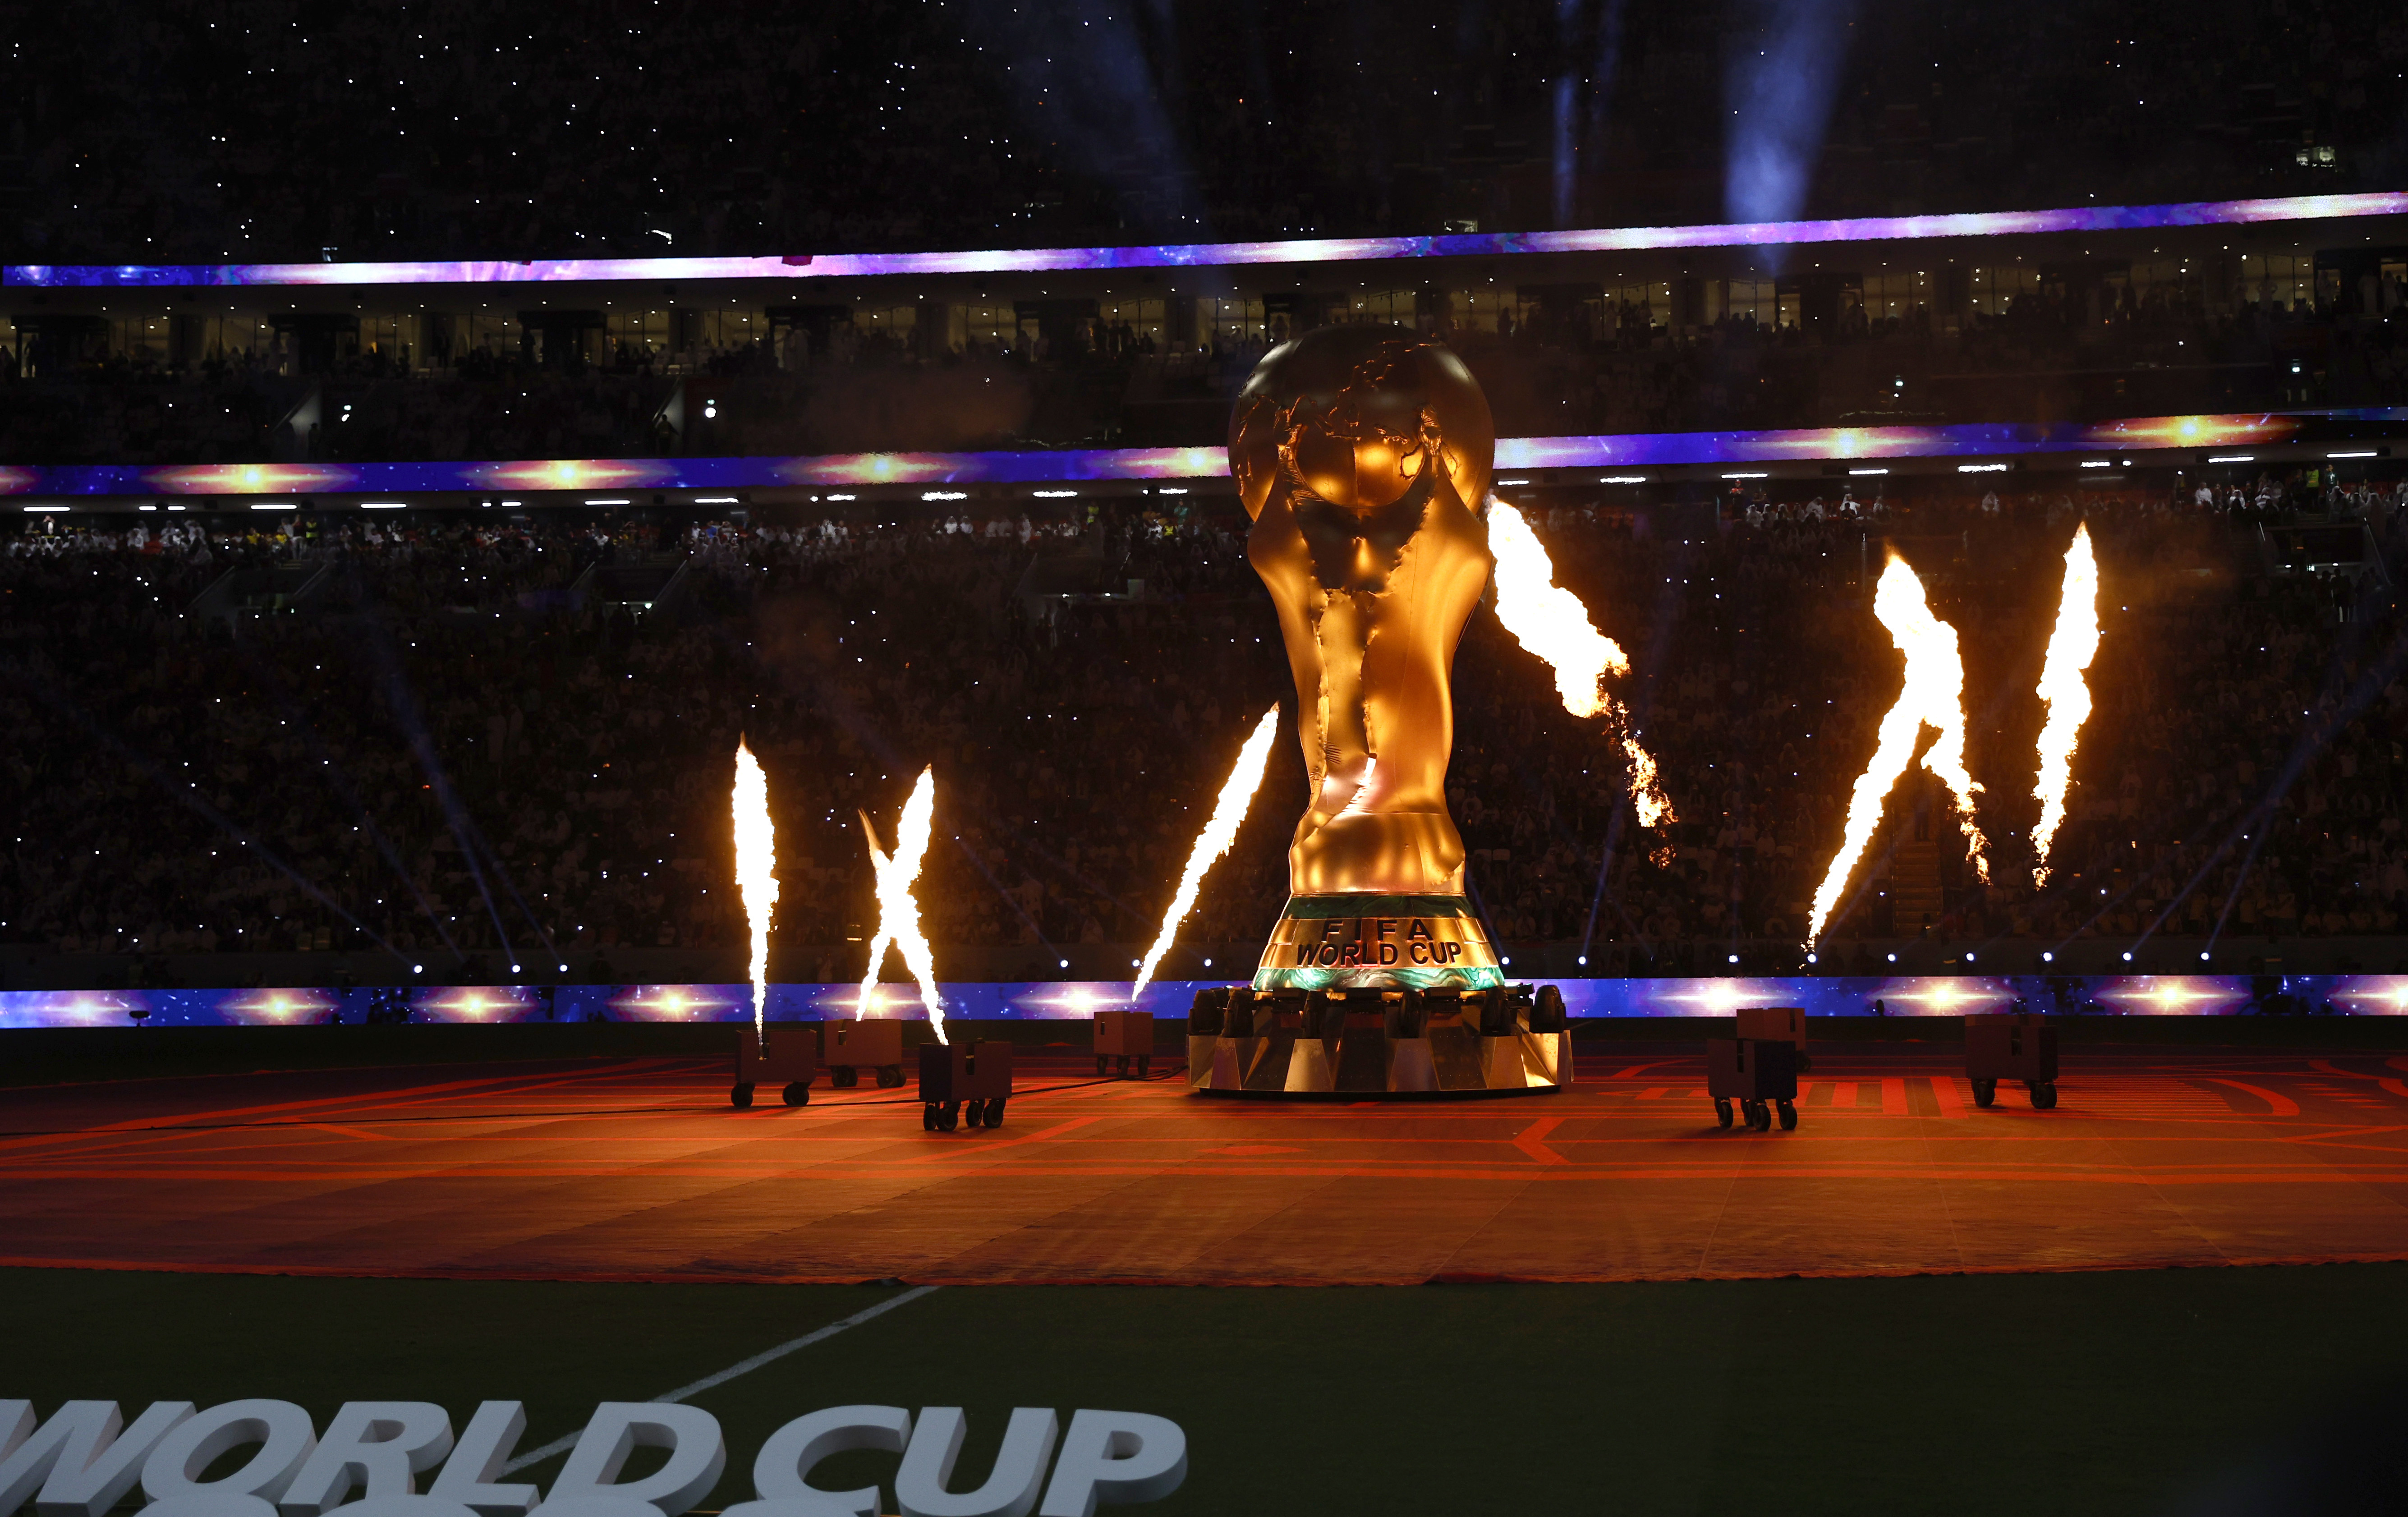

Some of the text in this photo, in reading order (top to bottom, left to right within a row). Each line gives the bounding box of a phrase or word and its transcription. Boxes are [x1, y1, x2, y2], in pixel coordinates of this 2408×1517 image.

[1321, 919, 1434, 942] FIFA
[1297, 942, 1461, 967] WORLD CUP
[0, 1398, 1188, 1517] WORLD CUP
